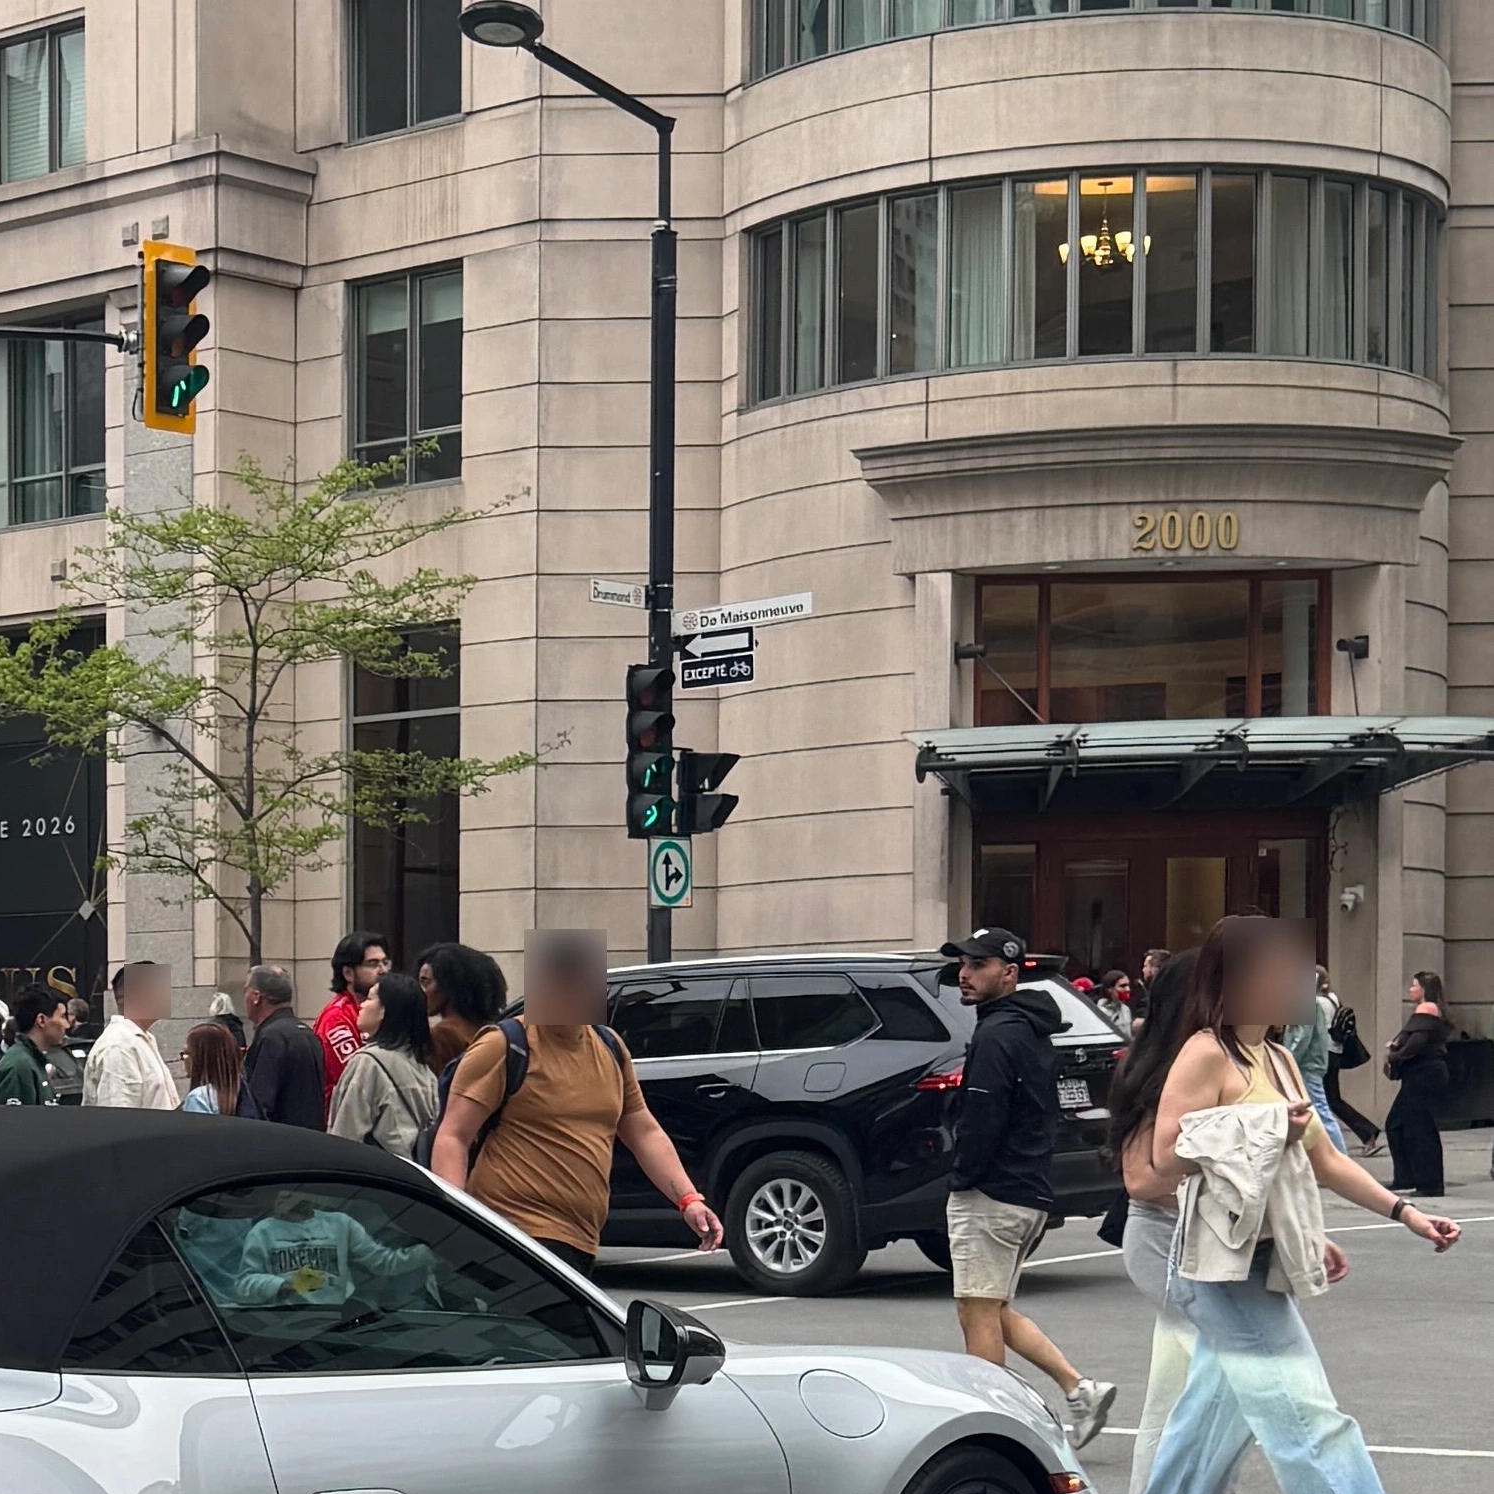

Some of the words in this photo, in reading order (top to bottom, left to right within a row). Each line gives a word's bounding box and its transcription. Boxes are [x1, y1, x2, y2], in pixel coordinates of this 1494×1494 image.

[1132, 510, 1239, 550] 2000
[593, 586, 631, 603] Drummond
[720, 603, 803, 625] Maisonneuve
[22, 815, 76, 838] 2026
